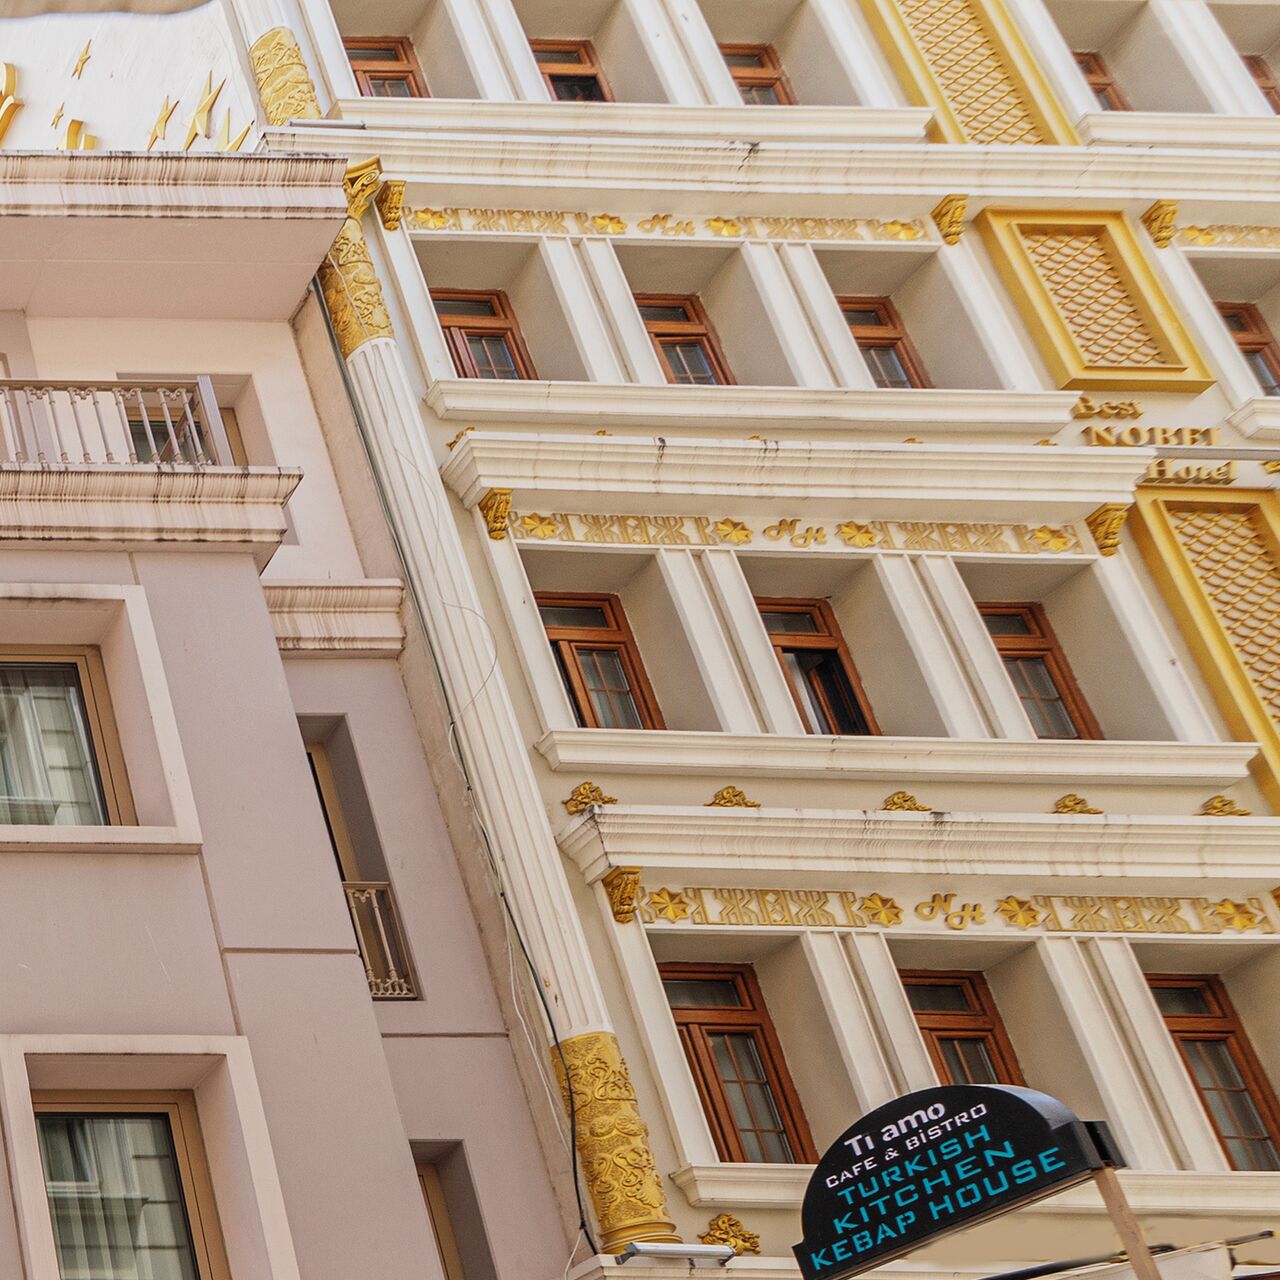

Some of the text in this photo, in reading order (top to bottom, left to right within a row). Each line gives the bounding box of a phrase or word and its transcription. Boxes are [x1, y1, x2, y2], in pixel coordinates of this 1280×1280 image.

[1141, 458, 1240, 486] Hotel
[881, 1102, 947, 1143] amo
[825, 1156, 878, 1189] CAFE
[884, 1147, 900, 1161] &
[833, 1140, 1016, 1235] KITCHEN
[836, 1124, 992, 1206] TURKISH
[810, 1146, 1067, 1271] KEBAP HOUSE
